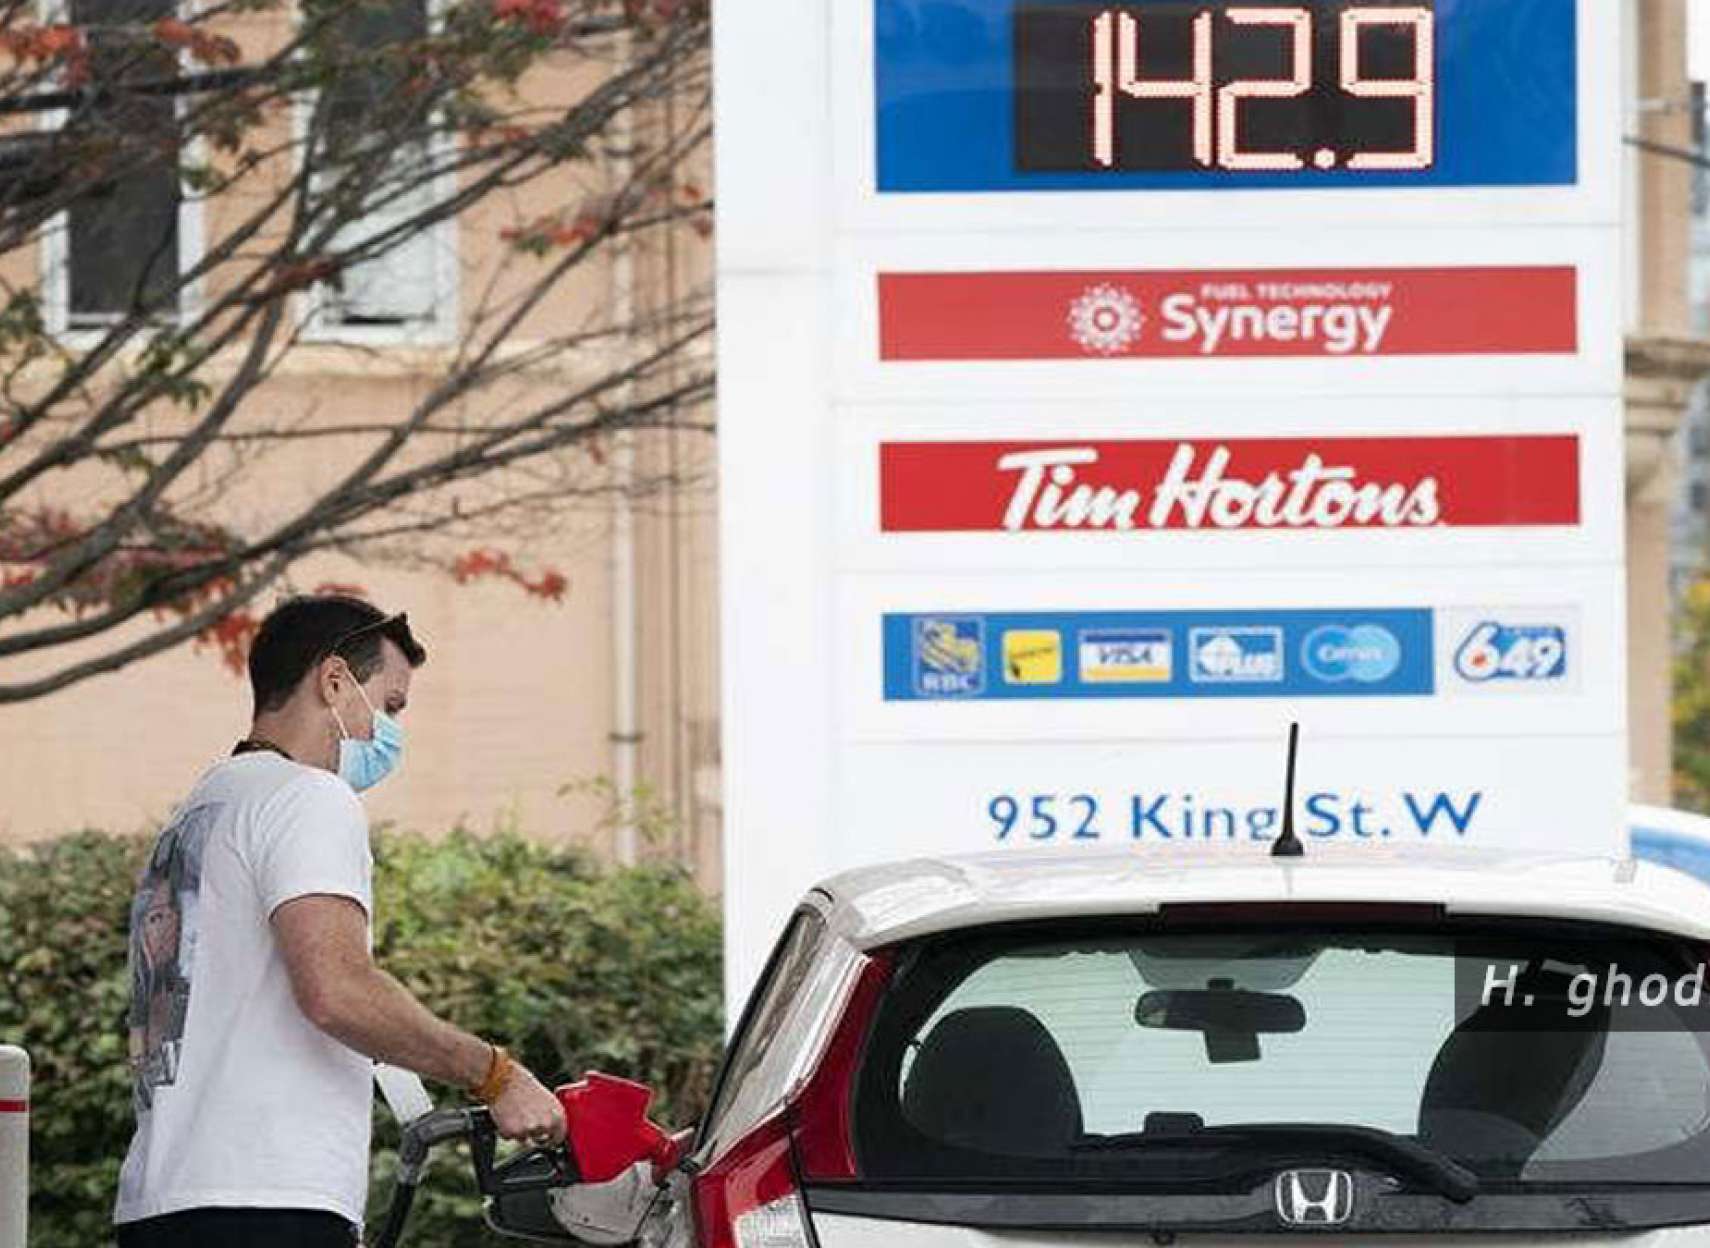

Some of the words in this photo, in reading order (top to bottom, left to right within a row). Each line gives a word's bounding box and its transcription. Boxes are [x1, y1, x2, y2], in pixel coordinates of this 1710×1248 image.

[1093, 6, 1434, 170] 142.9
[1161, 293, 1393, 353] Synergy
[997, 447, 1141, 531] Tim
[1148, 443, 1440, 529] Hortons
[987, 794, 1101, 840] 952
[1131, 794, 1277, 841] King
